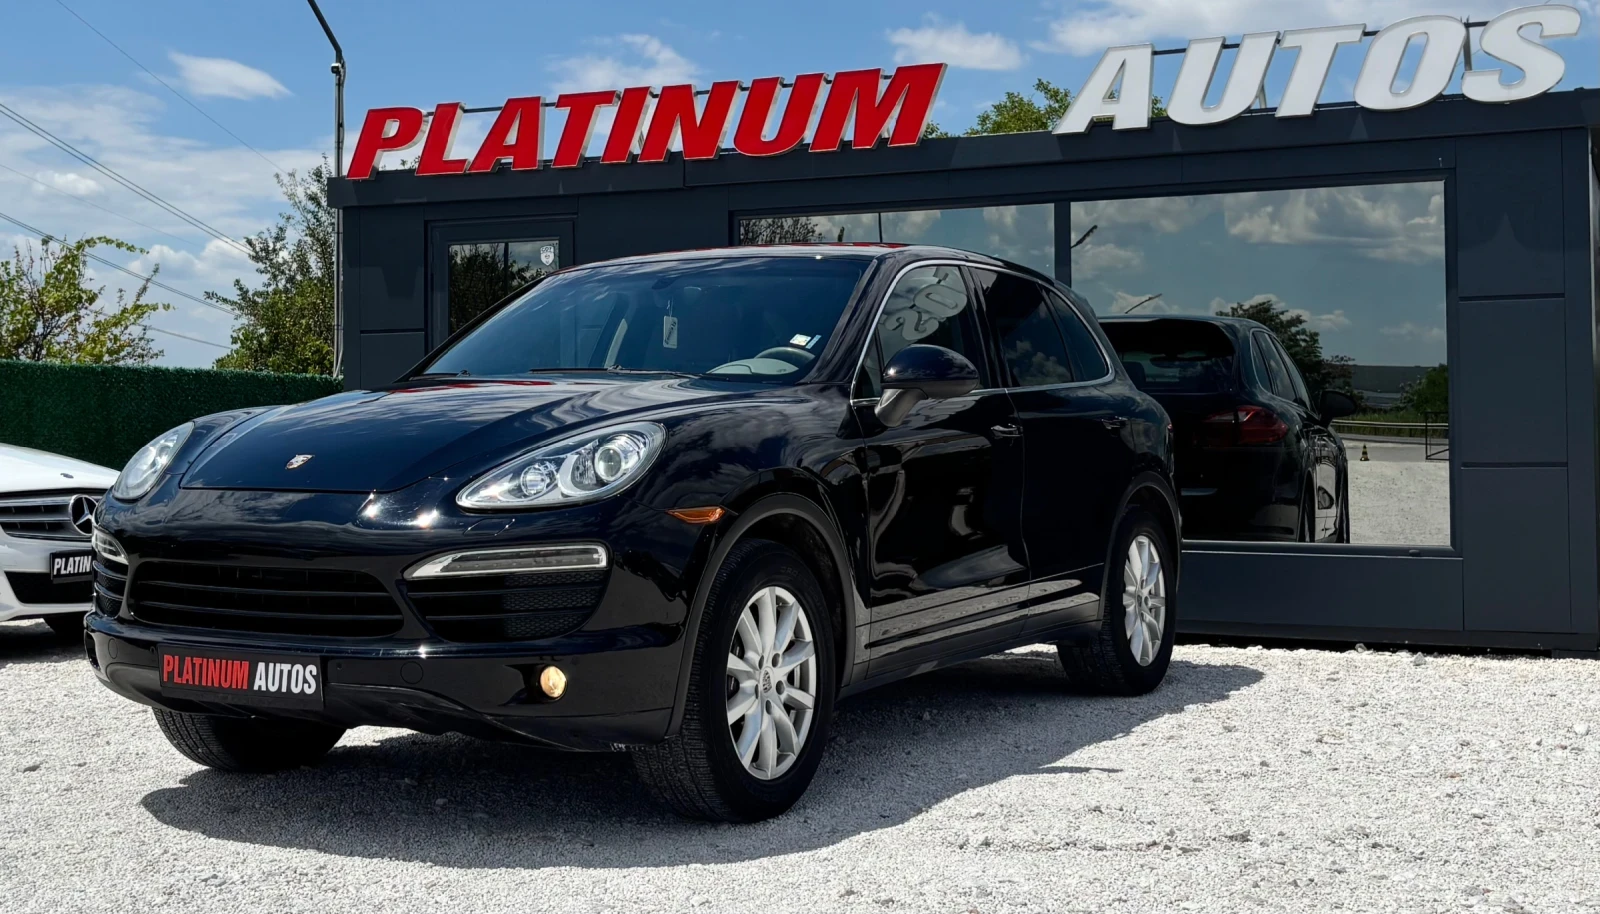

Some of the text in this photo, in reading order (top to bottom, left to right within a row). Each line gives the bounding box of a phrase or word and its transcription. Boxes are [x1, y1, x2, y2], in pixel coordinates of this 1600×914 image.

[346, 3, 1582, 181] PLATINUM AUTOS
[53, 555, 93, 576] PLATIN
[163, 654, 318, 695] PLATINUM AUTOS
